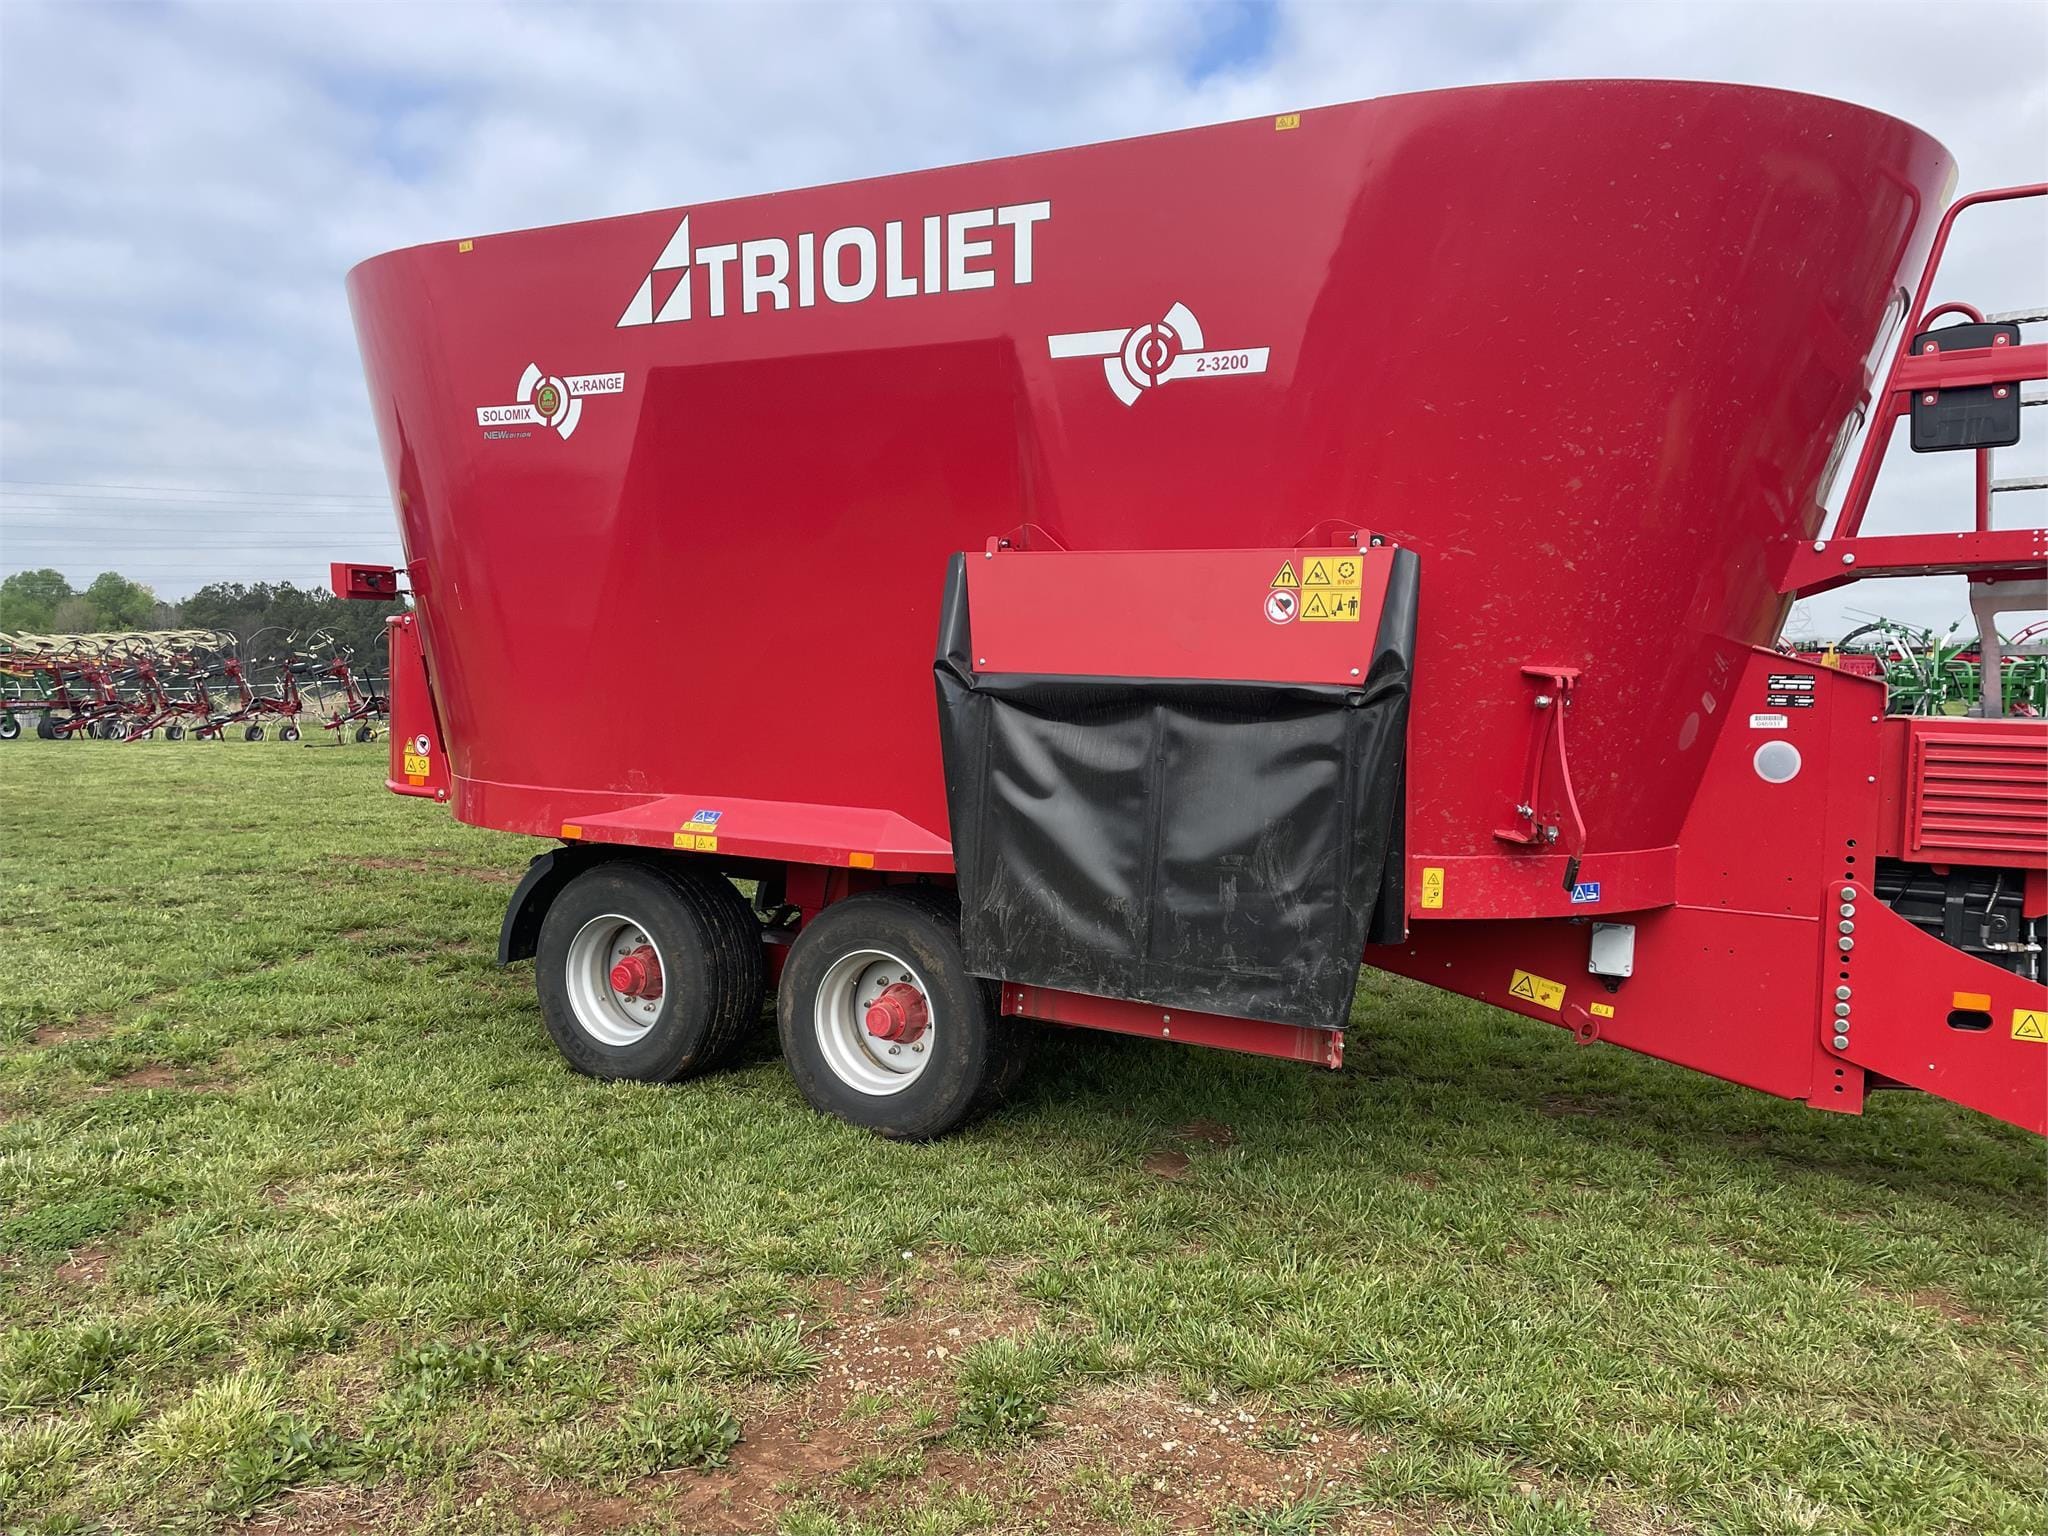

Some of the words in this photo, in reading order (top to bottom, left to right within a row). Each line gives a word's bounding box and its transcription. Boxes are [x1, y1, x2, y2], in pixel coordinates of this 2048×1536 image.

[695, 200, 1051, 318] TRIOLIET
[1196, 355, 1249, 372] 2-3200
[572, 377, 622, 392] X-RANGE
[482, 408, 531, 422] SOLOMIX
